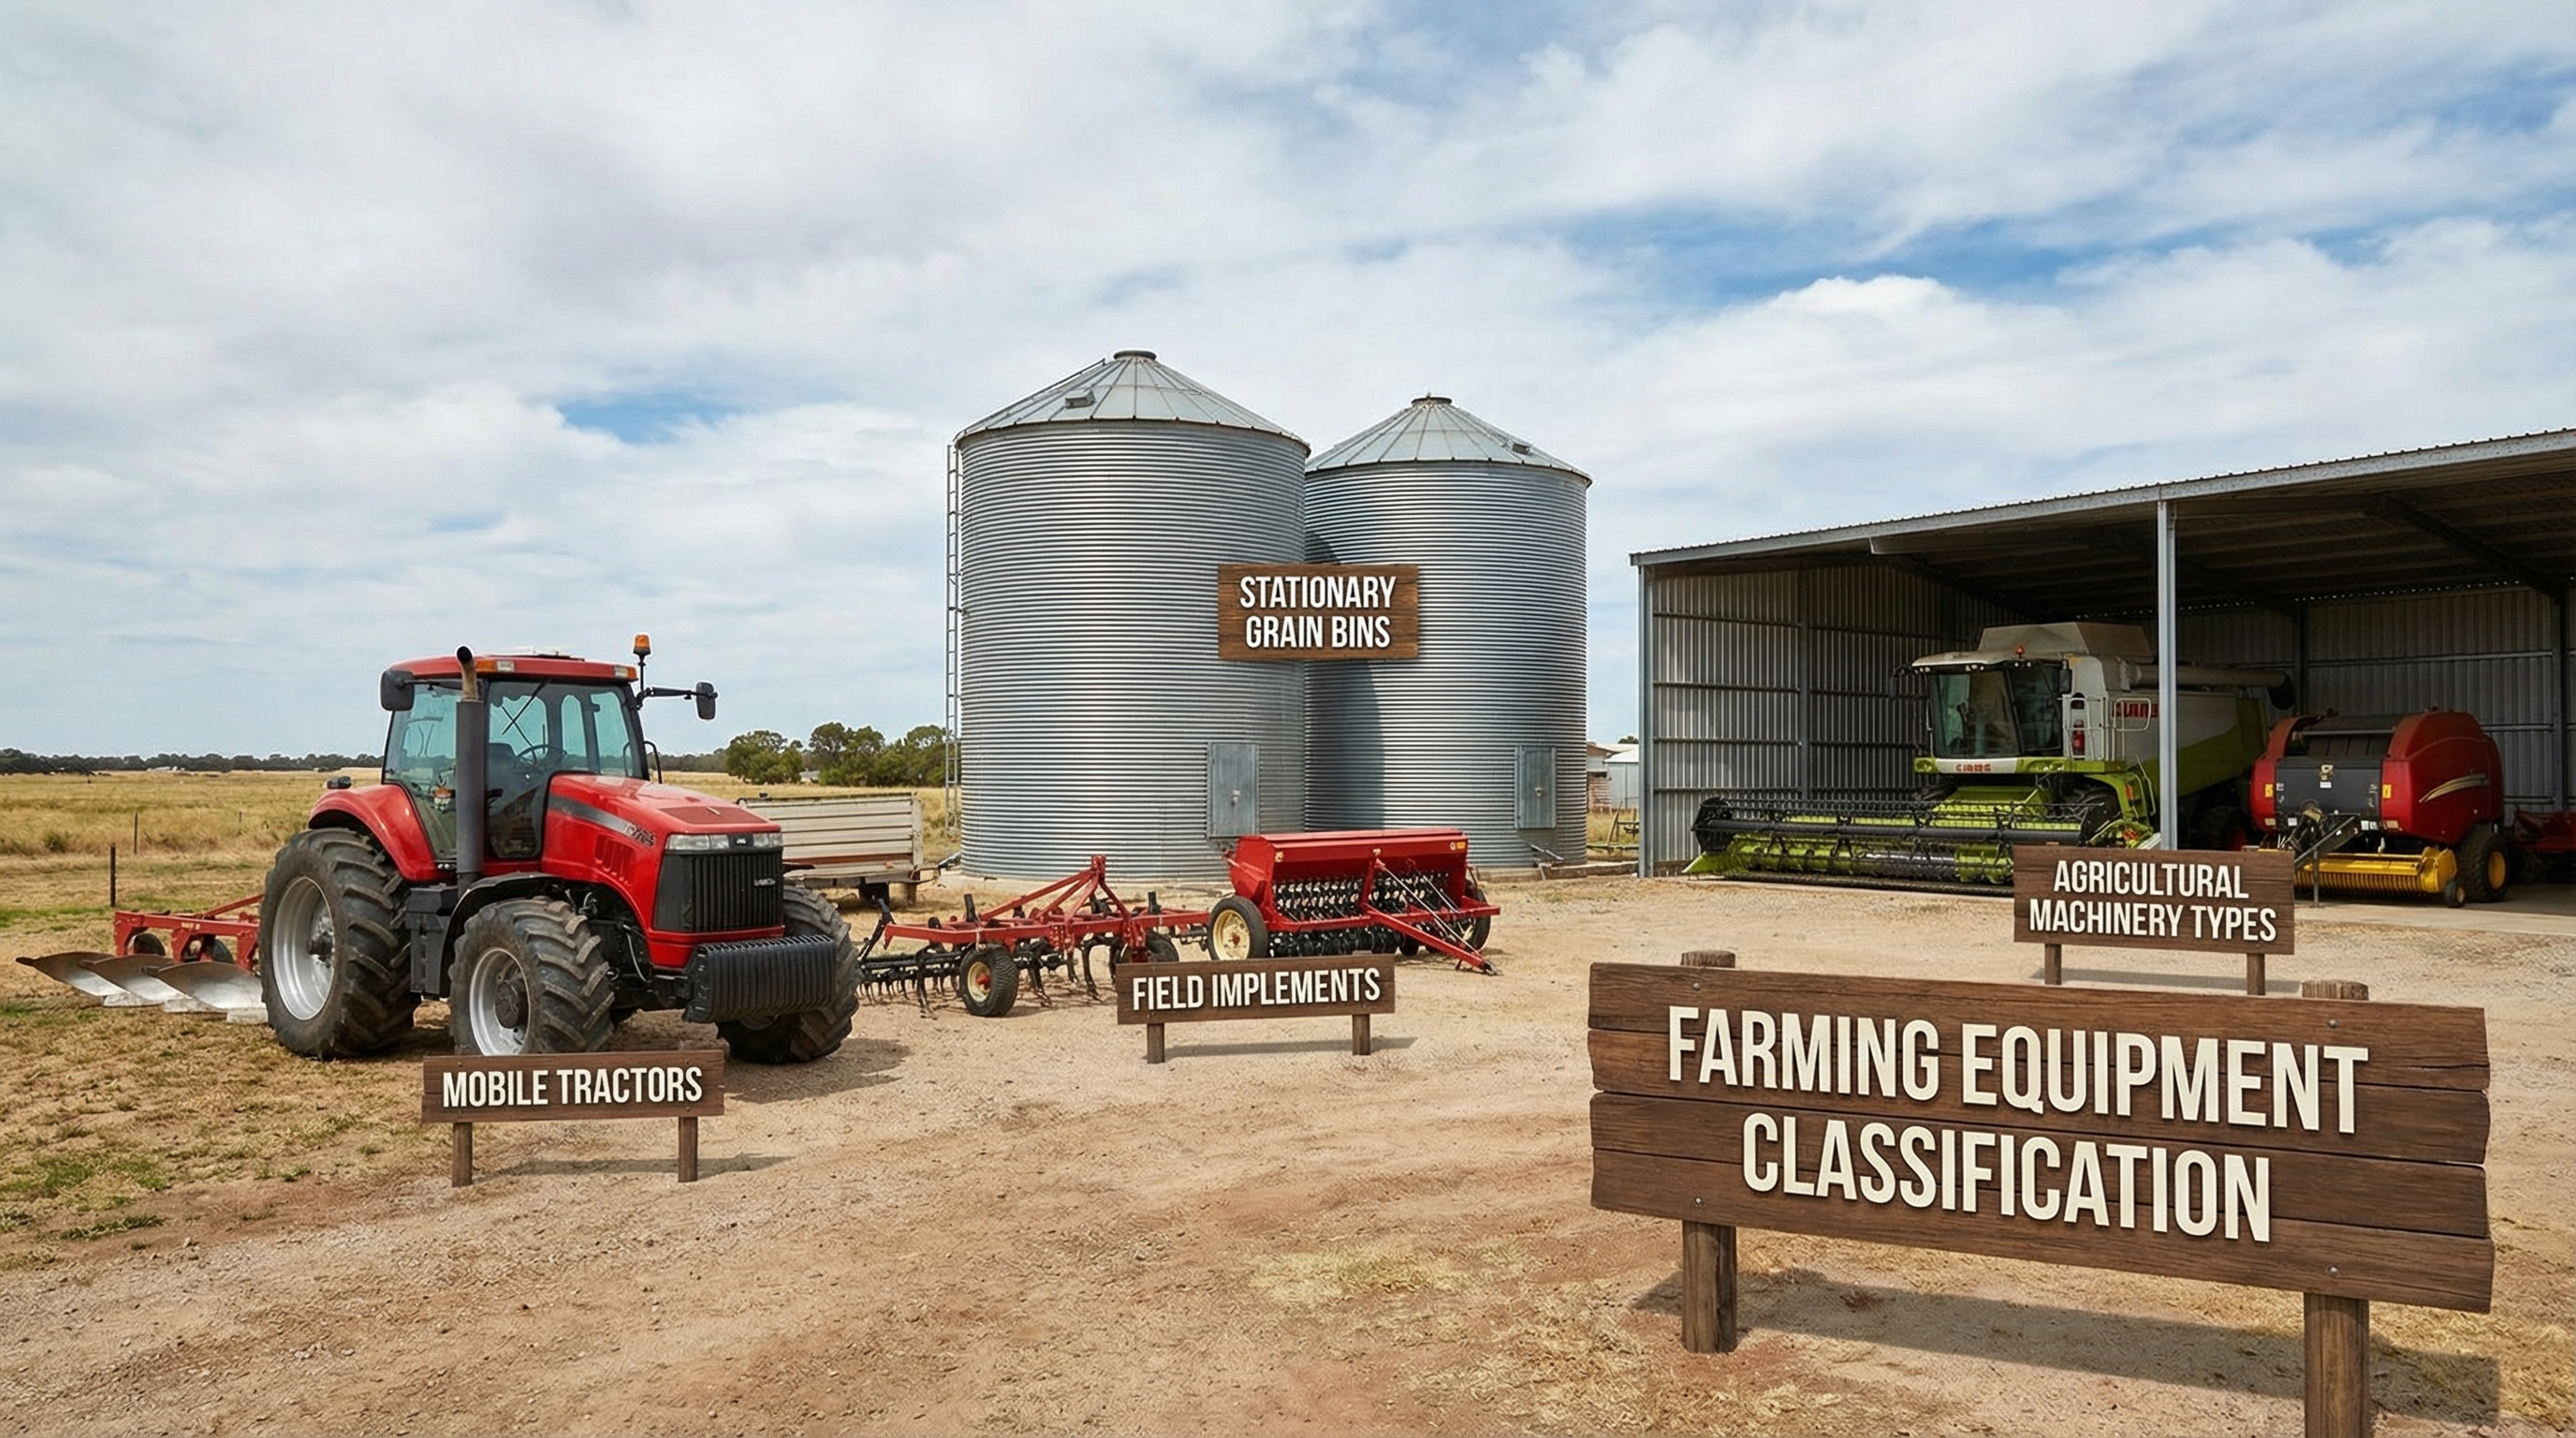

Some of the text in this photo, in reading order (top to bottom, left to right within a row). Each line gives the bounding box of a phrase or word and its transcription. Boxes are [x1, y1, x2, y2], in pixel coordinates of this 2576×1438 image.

[1239, 576, 1397, 609] STATIONARY
[1246, 615, 1390, 648] GRAIN BINS
[2054, 859, 2249, 899] AGRICULTURAL
[2029, 899, 2276, 942] MACHINERY TYPES
[1133, 967, 1381, 1010] FIELD IMPLEMENTS
[443, 1066, 702, 1108] MOBILE TRACTORS
[1669, 1005, 2369, 1135] FARMING EQUIPMENT
[1742, 1112, 2270, 1242] CLASSIFICATION
